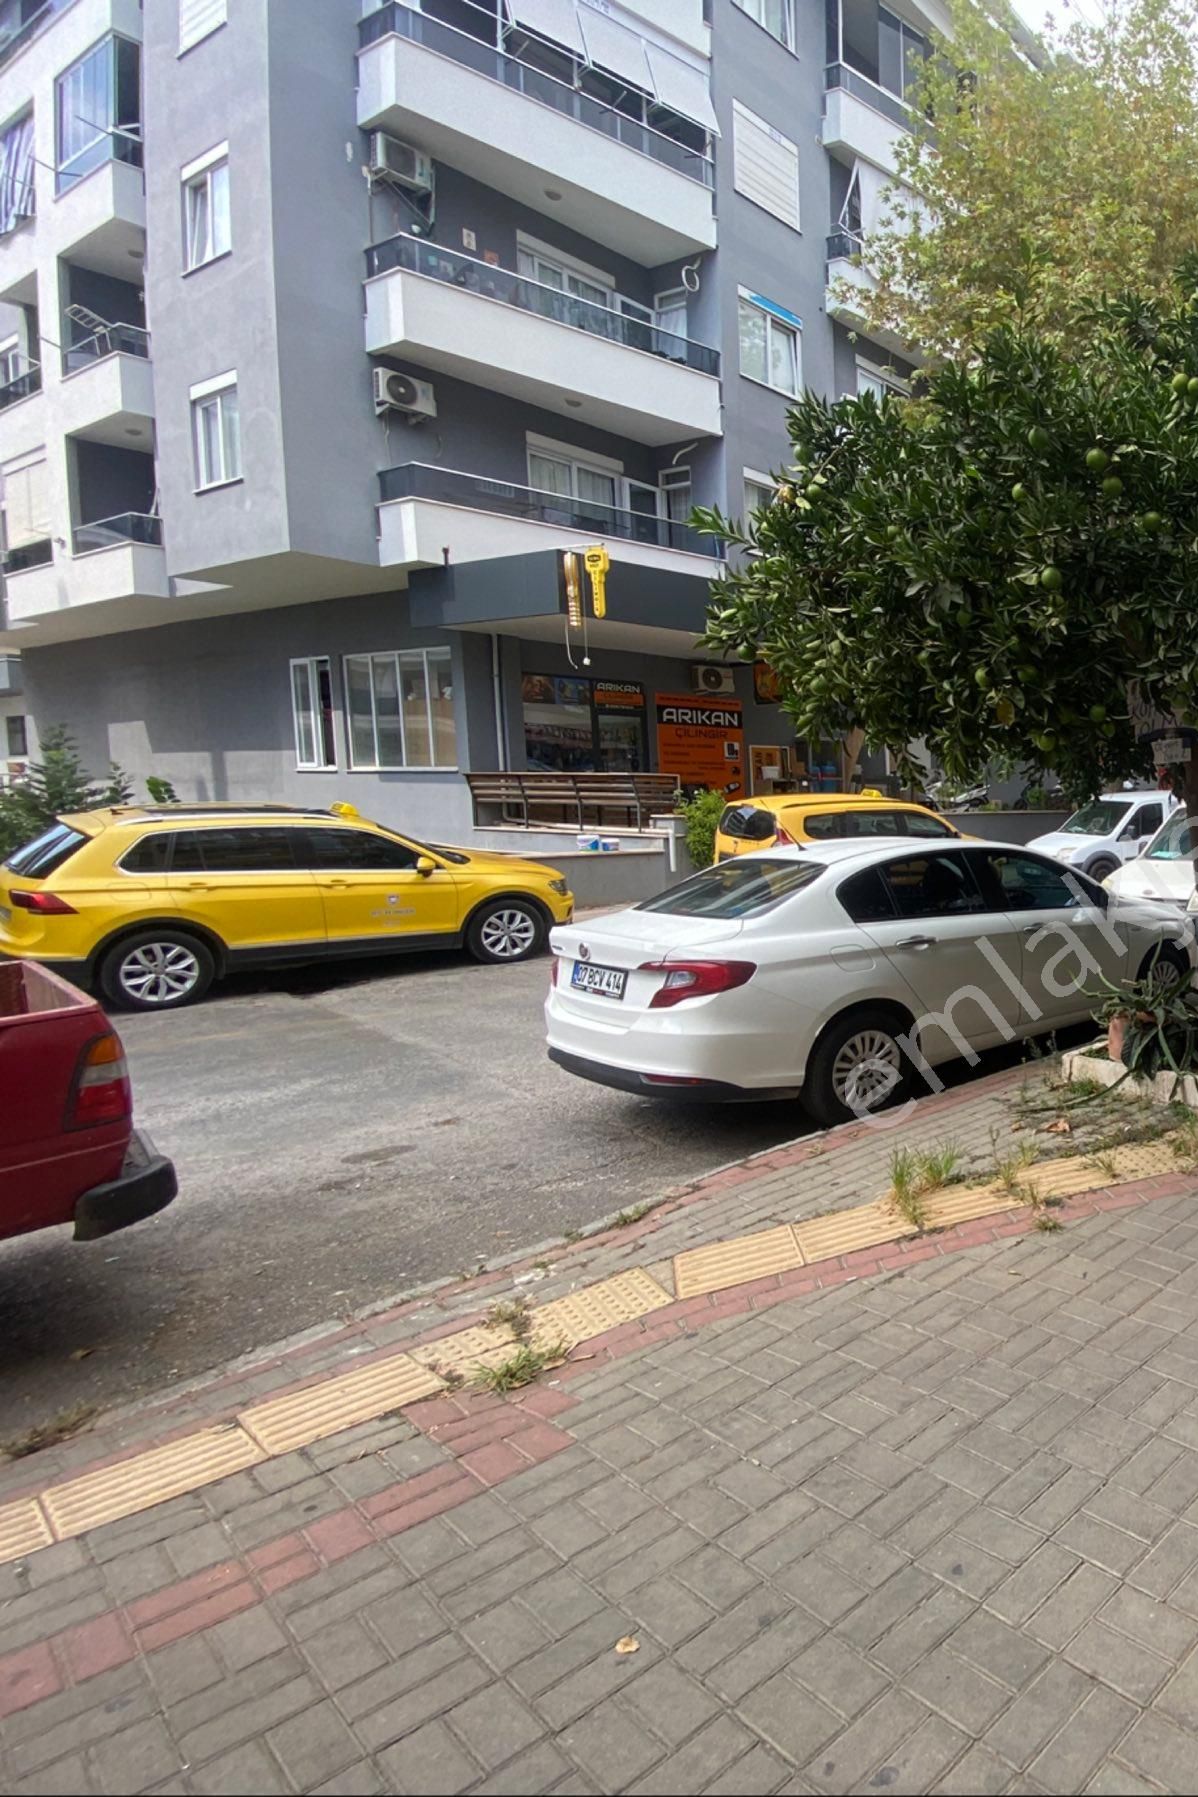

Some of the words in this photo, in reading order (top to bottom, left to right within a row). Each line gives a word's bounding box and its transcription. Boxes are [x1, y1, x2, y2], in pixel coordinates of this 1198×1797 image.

[596, 682, 641, 694] ARIKAN
[662, 707, 739, 727] ARIKAN
[587, 969, 605, 987] BCV
[606, 972, 621, 991] 414
